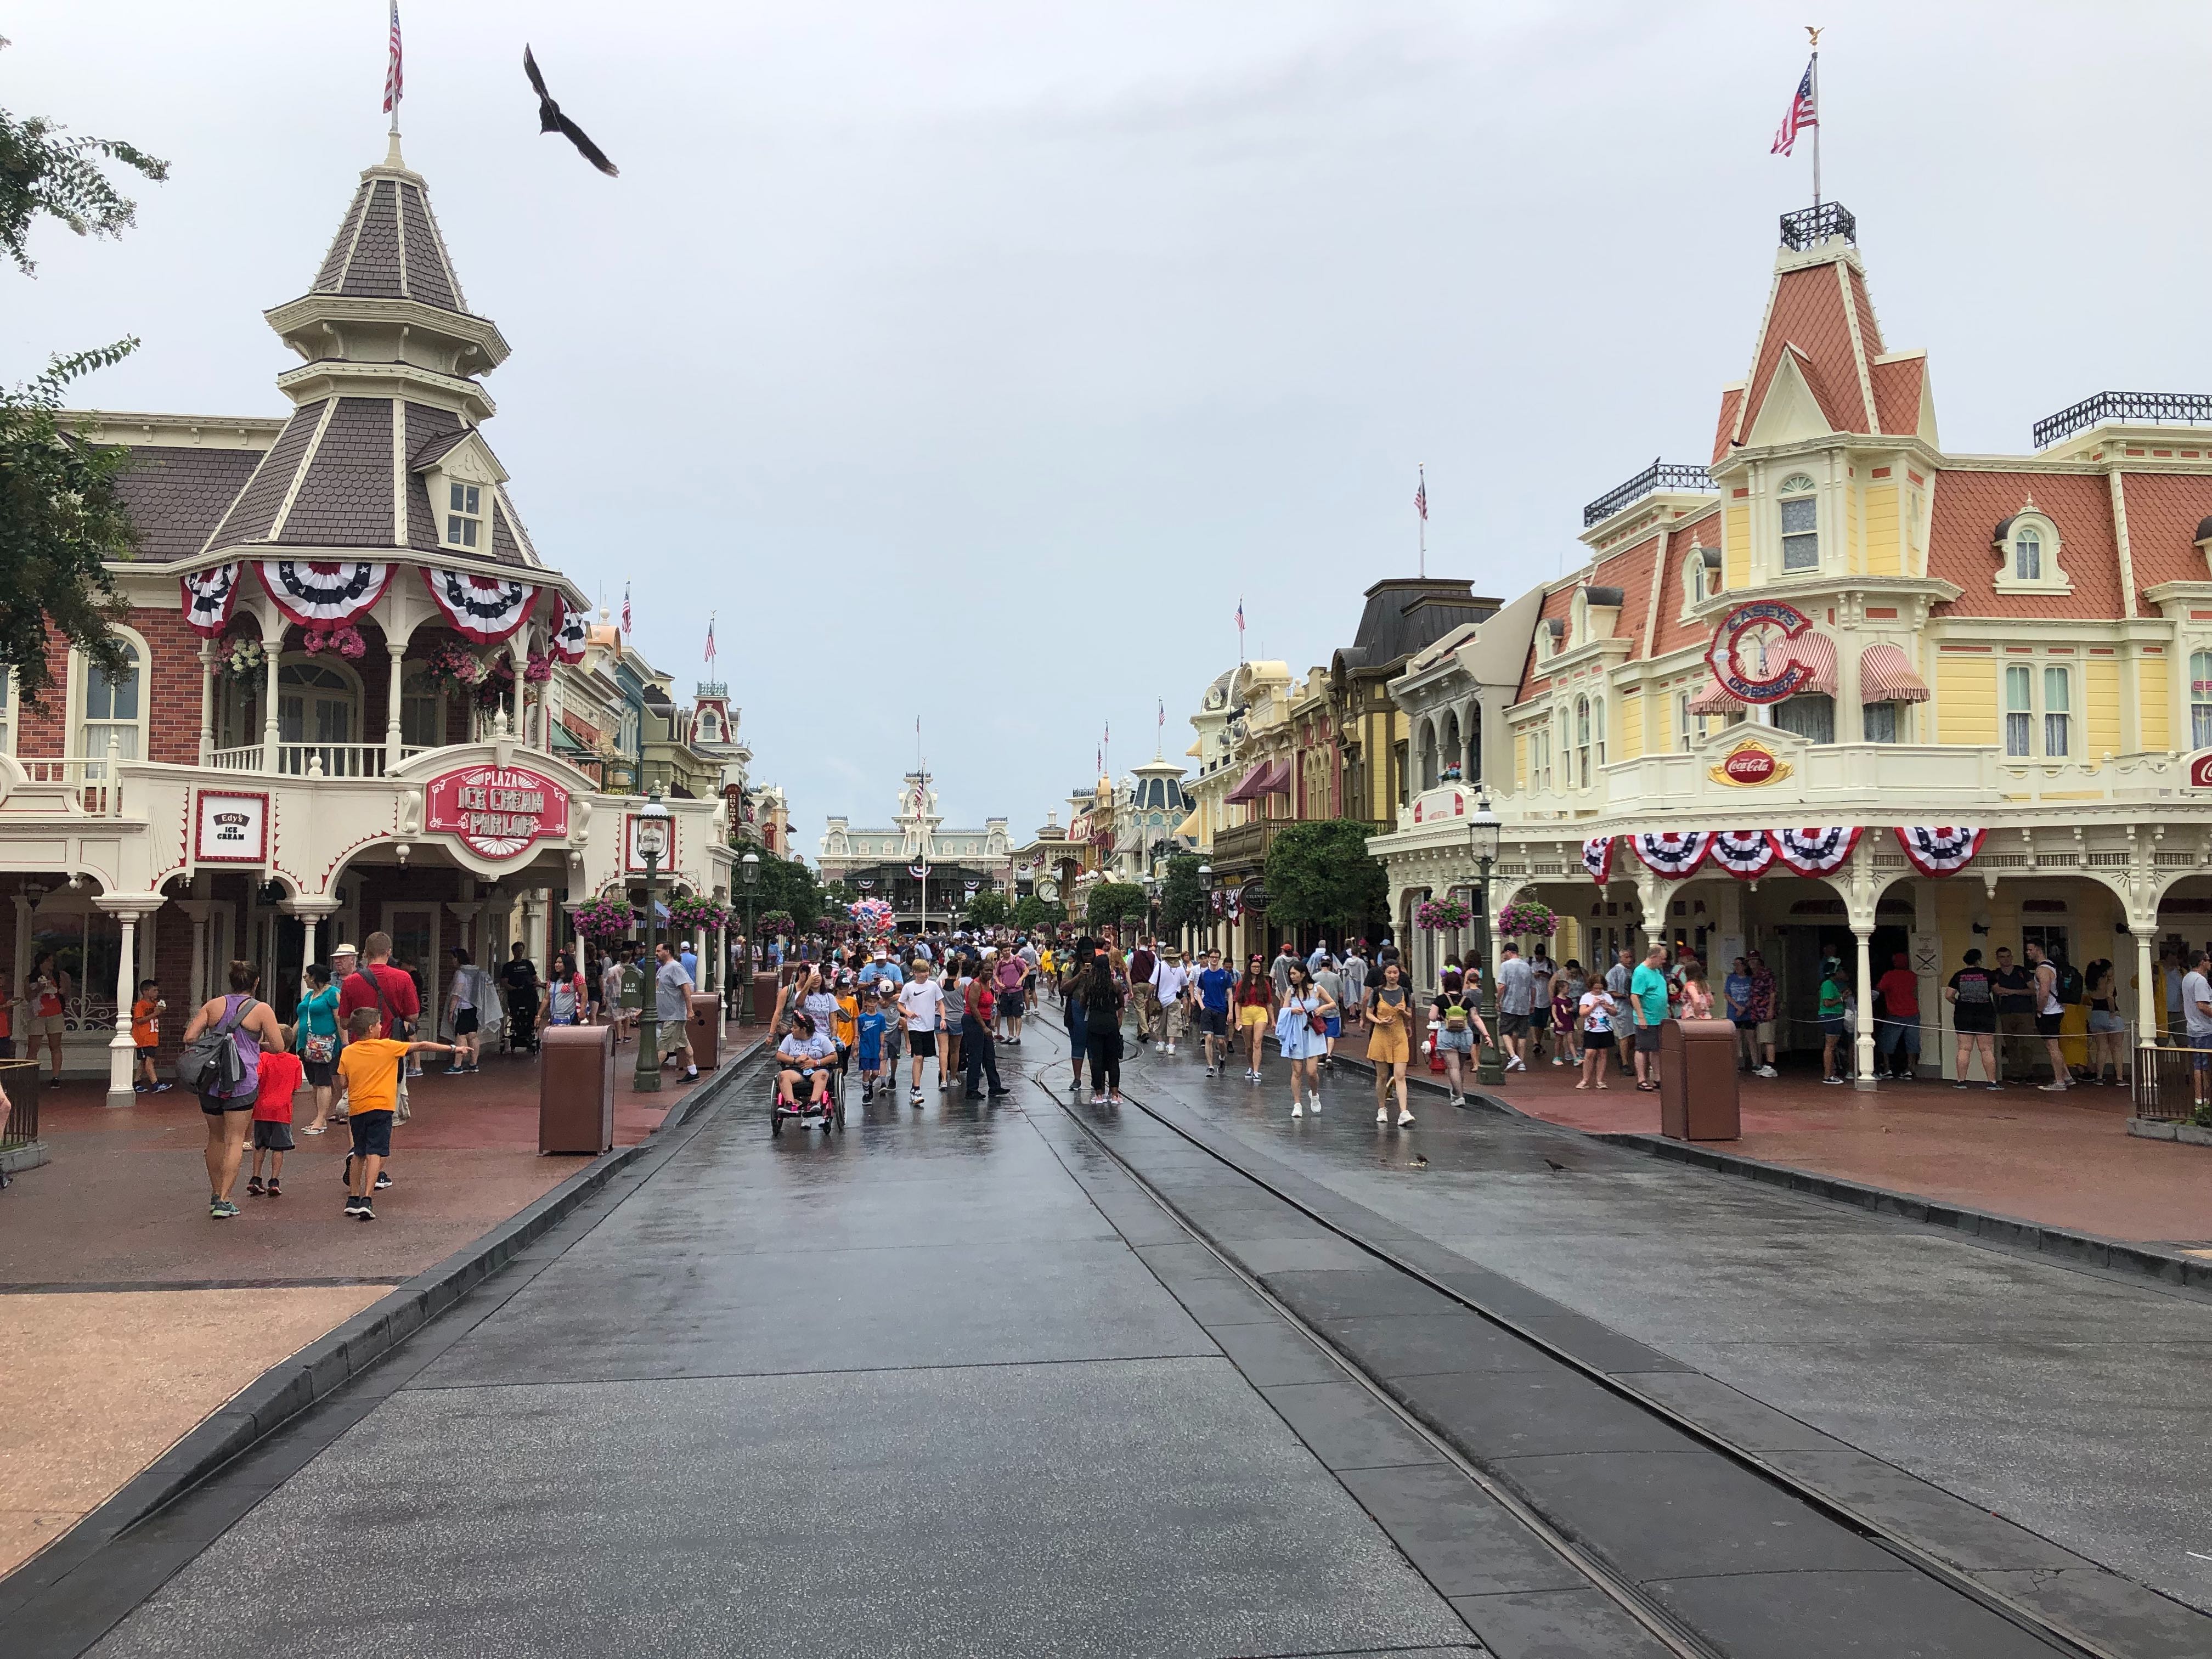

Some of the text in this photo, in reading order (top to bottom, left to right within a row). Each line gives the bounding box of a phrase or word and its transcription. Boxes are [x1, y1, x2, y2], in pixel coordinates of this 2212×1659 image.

[1728, 758, 1770, 773] Coca-Cola
[484, 770, 517, 788] PLAZA
[457, 787, 544, 813] ICE CREAM
[221, 814, 243, 823] Edy's
[469, 812, 533, 837] PARLOR
